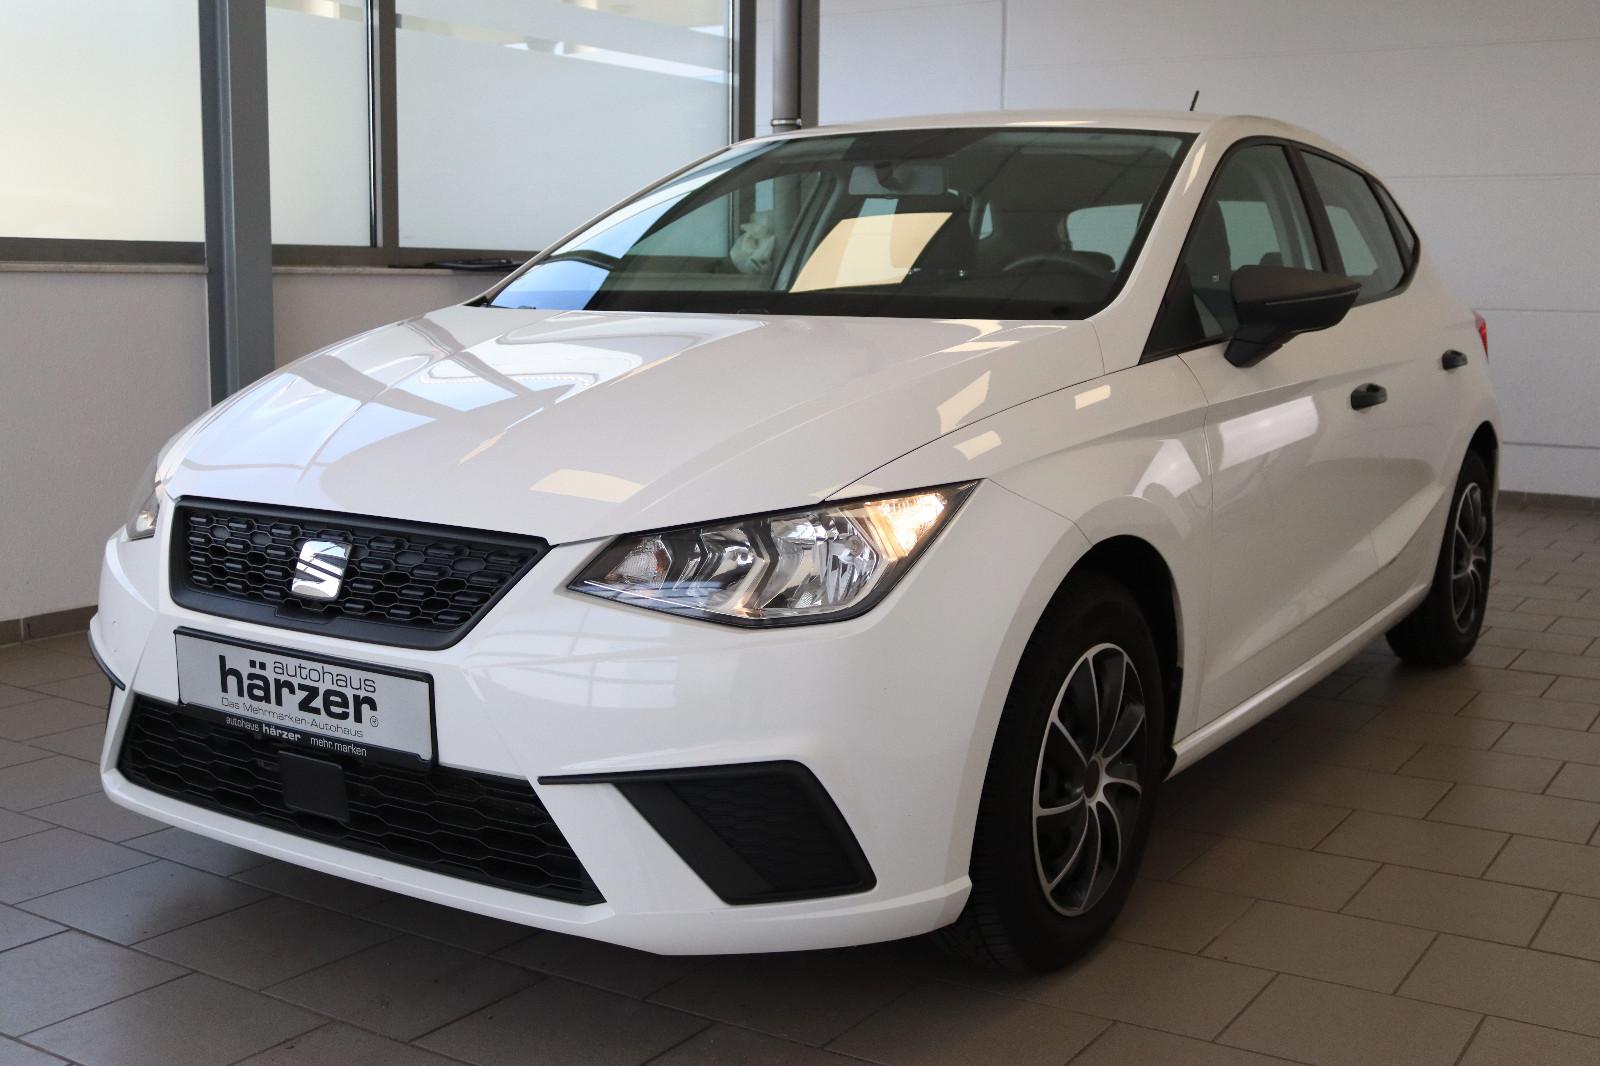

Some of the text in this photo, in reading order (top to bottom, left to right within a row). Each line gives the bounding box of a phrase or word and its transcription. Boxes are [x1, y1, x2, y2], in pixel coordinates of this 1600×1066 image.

[218, 654, 378, 724] härzer
[273, 661, 376, 693] autohaus
[221, 697, 364, 738] Das Mehrmarken-Autohaus
[226, 716, 260, 732] autohaus
[262, 723, 302, 742] härzer
